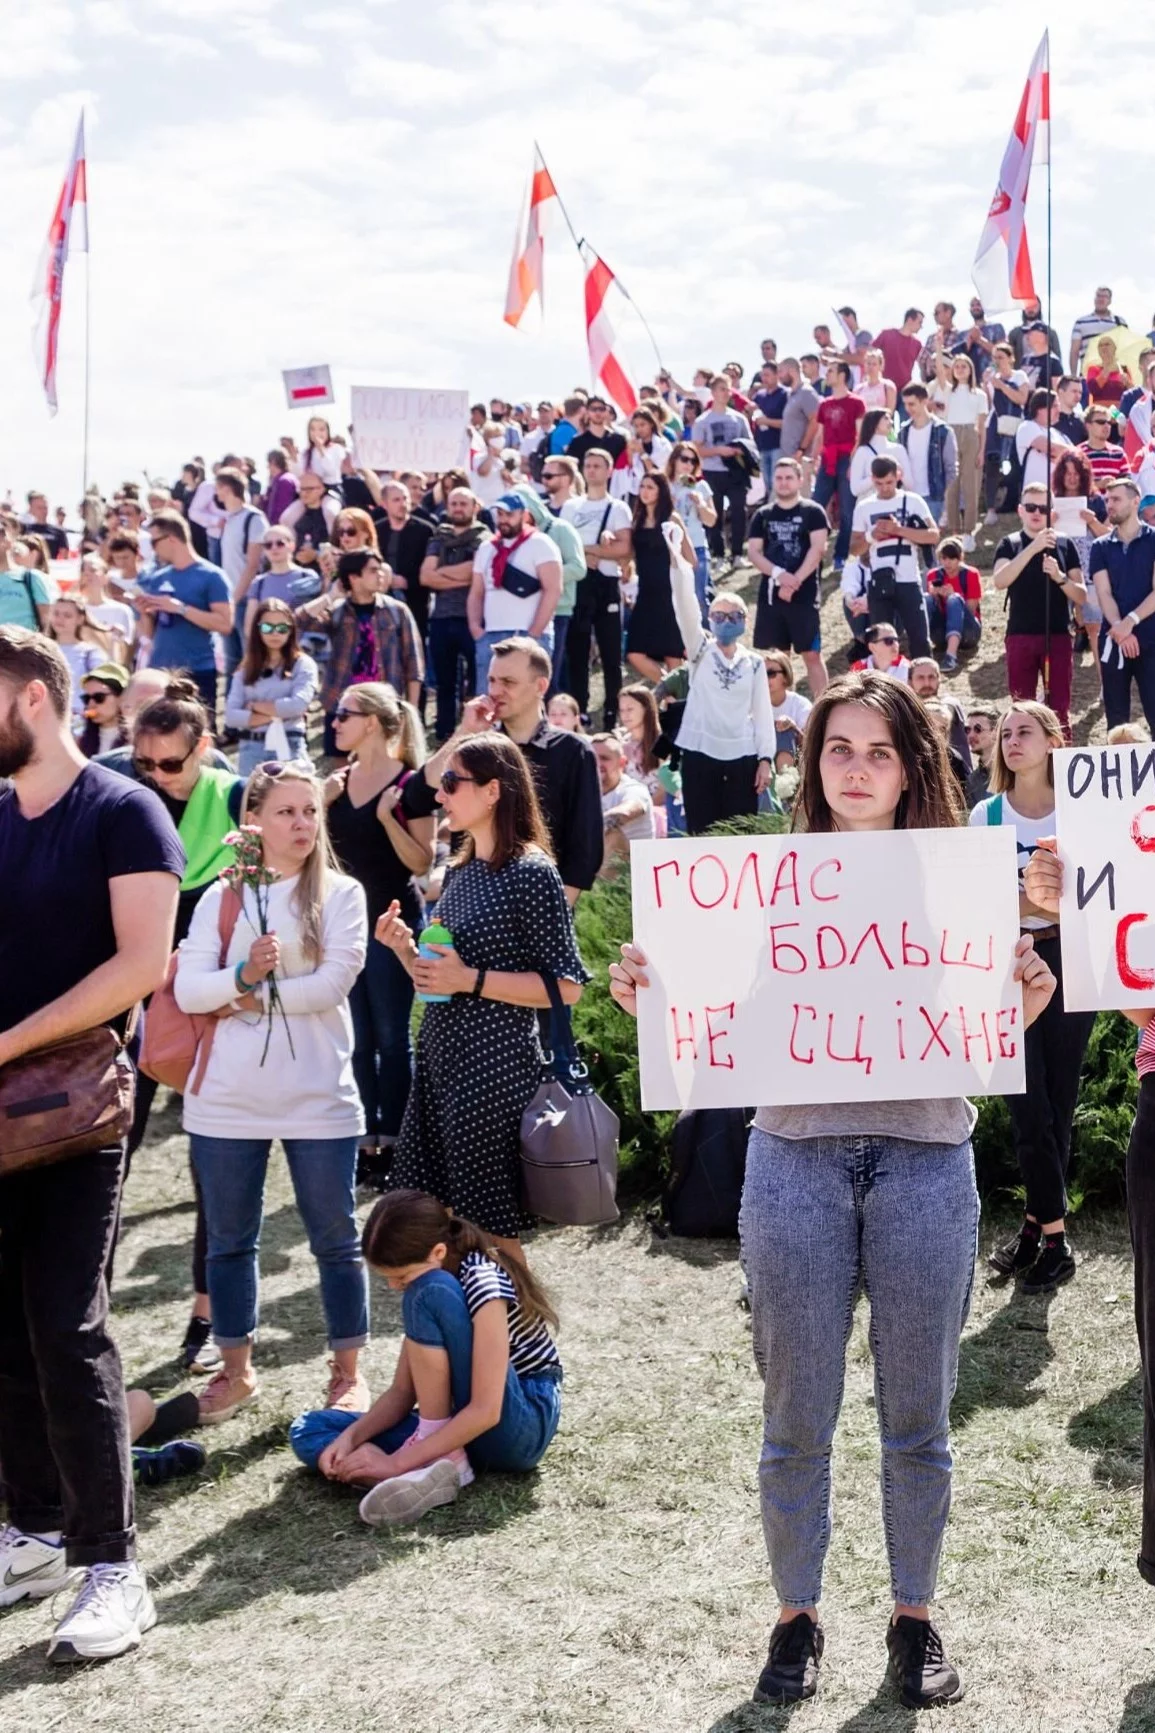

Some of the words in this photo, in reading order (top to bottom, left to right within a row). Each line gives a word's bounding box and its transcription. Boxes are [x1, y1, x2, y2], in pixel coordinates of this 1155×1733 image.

[653, 851, 842, 909] ГОЛАС
[1076, 861, 1115, 910] И
[769, 921, 994, 974] БОЛЬШ
[670, 1001, 736, 1070] НЕ
